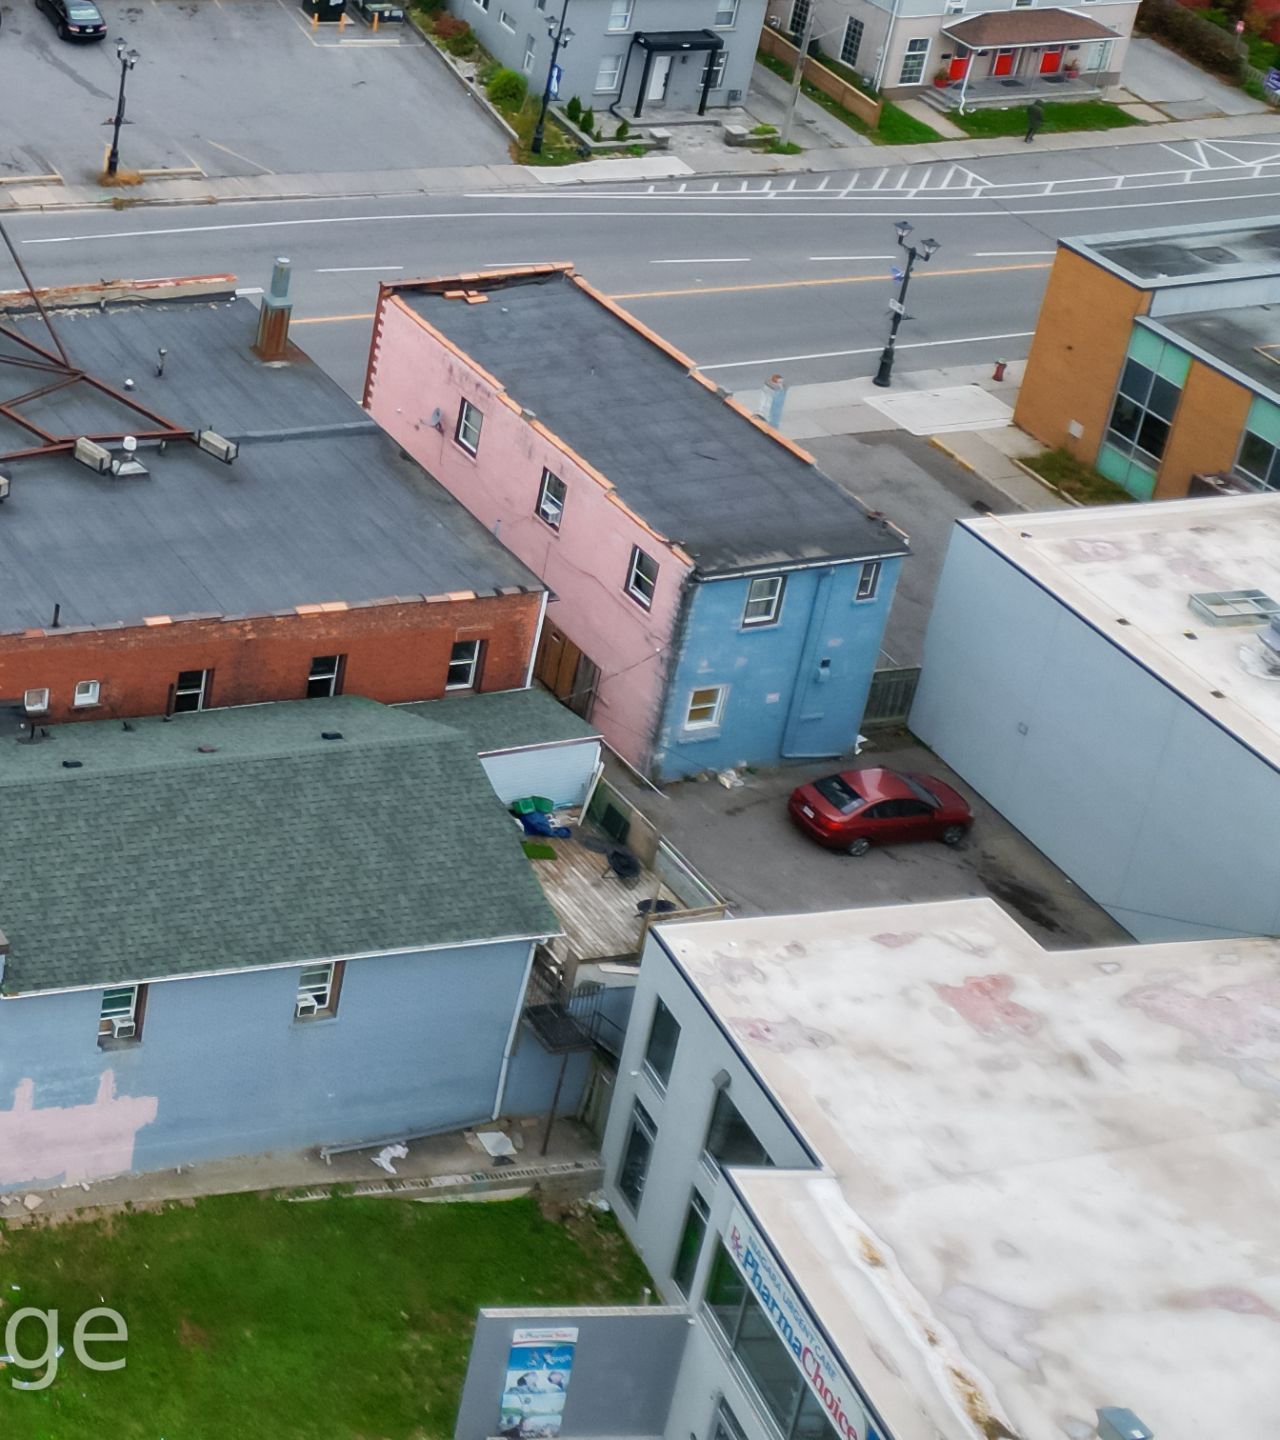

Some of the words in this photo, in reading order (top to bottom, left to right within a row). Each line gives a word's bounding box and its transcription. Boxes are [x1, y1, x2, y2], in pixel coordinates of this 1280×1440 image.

[743, 1245, 858, 1440] PharmaChoice
[748, 1235, 782, 1291] NIAGARA
[782, 1294, 815, 1343] URGENT
[815, 1345, 838, 1382] CARE
